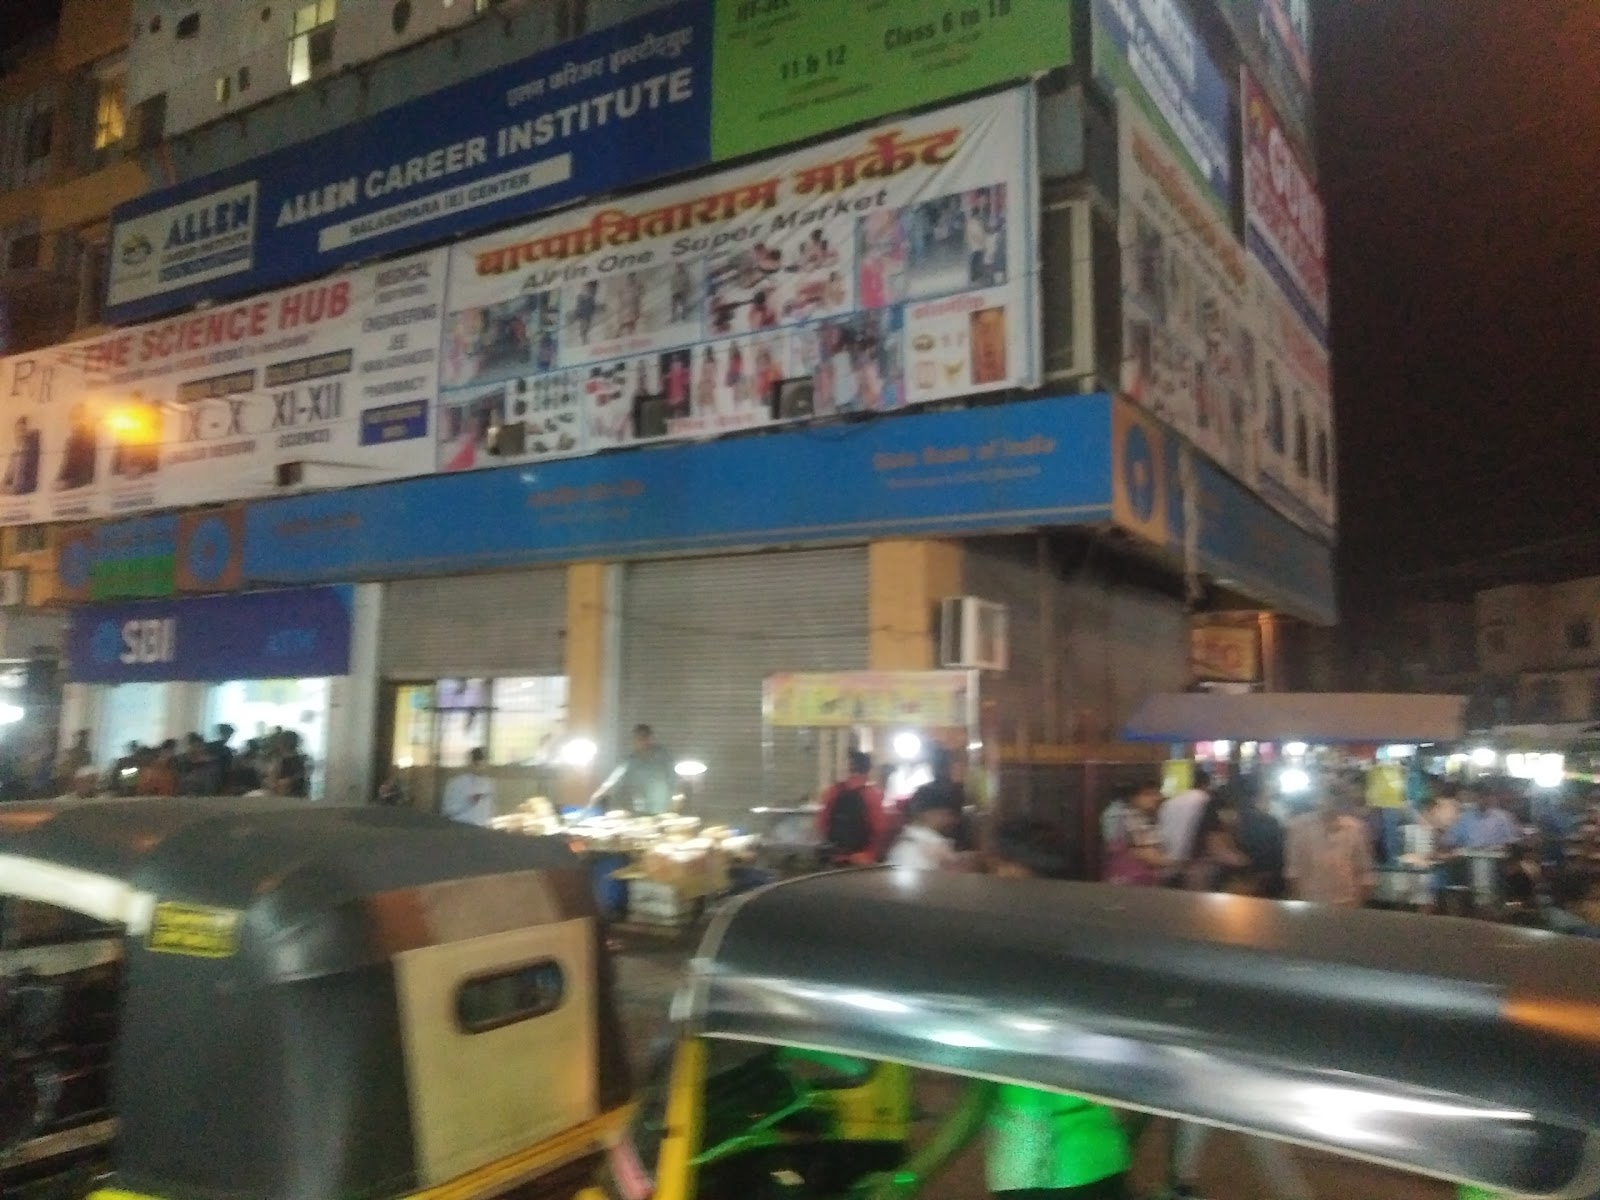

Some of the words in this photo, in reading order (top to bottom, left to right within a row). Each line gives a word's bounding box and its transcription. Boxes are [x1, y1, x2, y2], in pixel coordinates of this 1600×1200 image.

[276, 176, 358, 228] ALLEN
[364, 136, 488, 199] CAREER
[497, 66, 694, 158] INSTITUTE
[795, 128, 961, 195] मार्केट
[163, 194, 251, 250] ALLEN
[597, 250, 655, 273] One
[671, 223, 762, 257] Super
[771, 189, 888, 228] Market
[139, 301, 270, 362] SCIENCE
[276, 280, 351, 331] HUB
[120, 618, 176, 664] SBI
